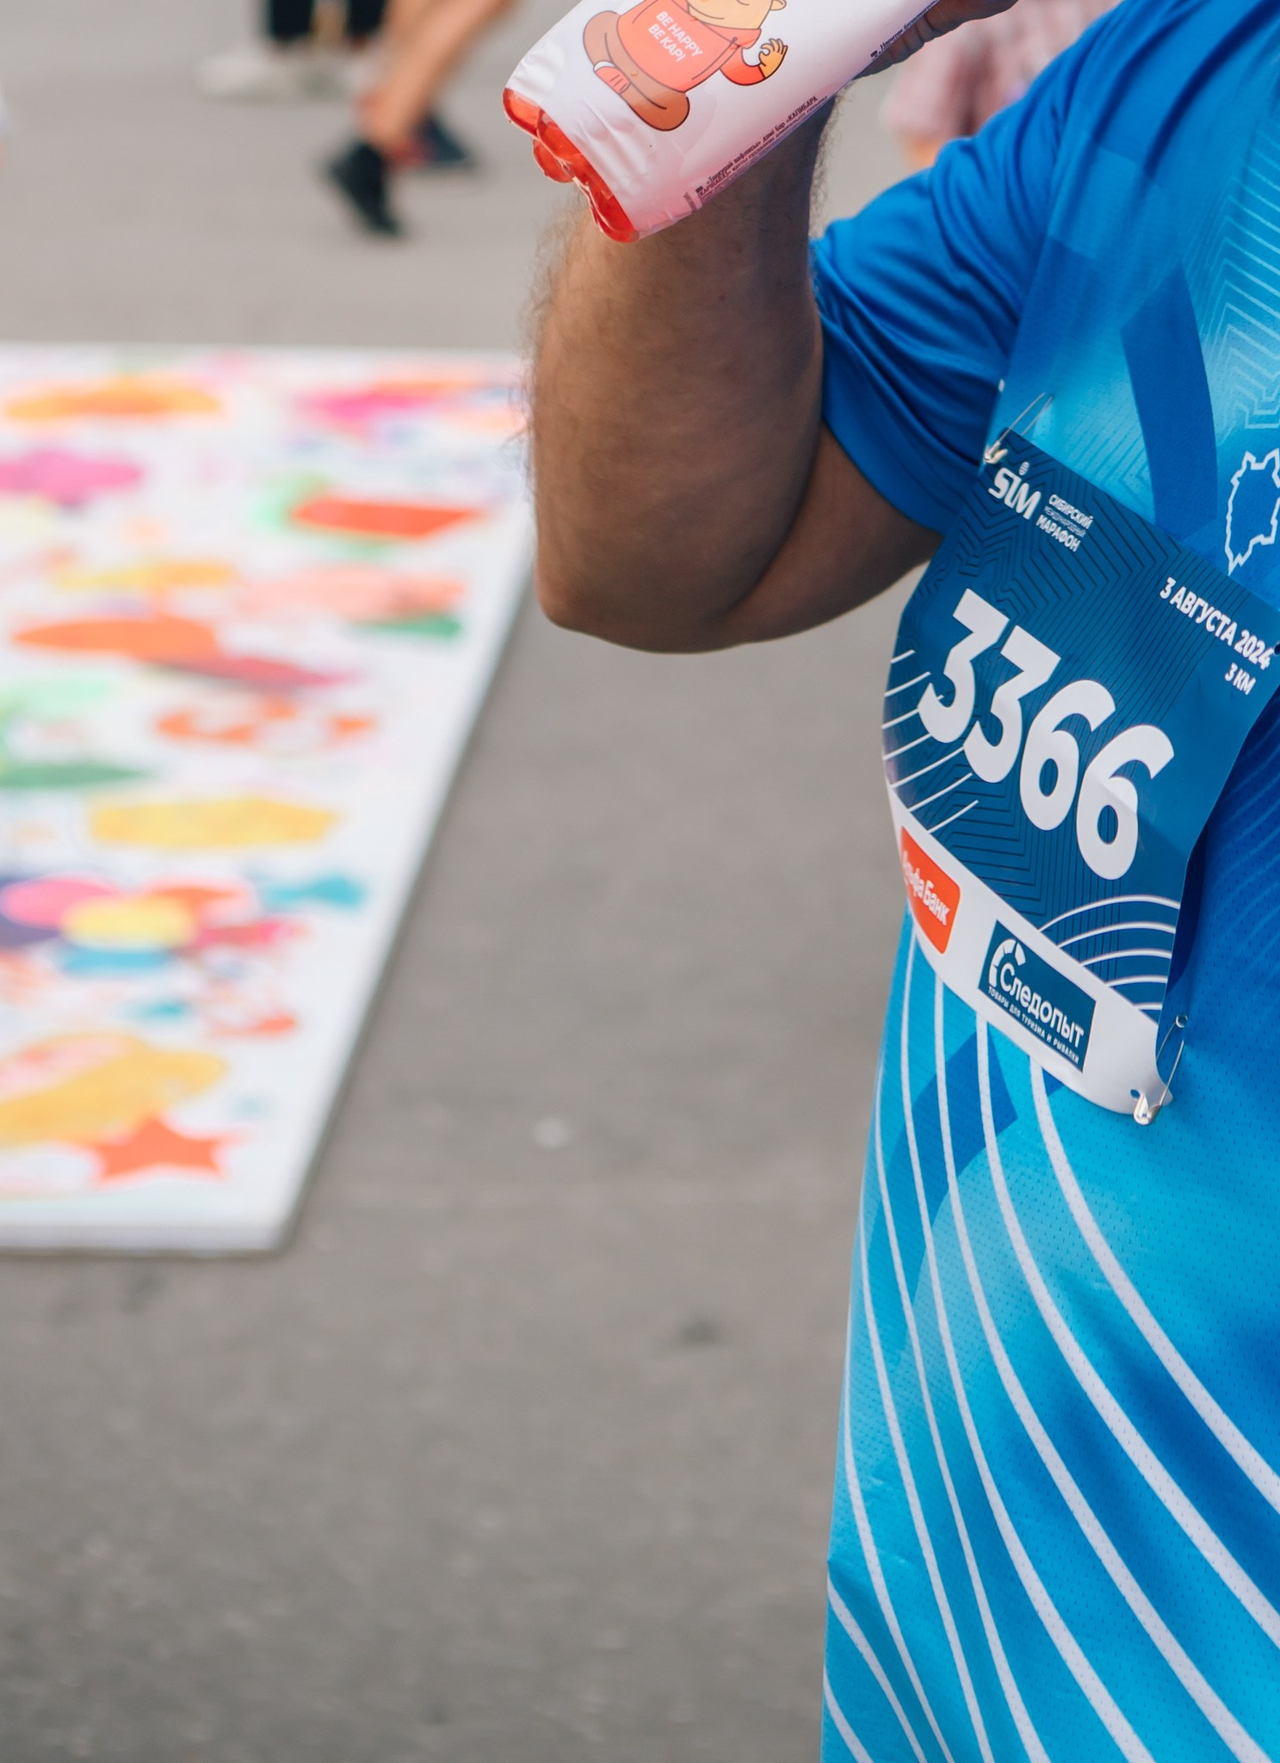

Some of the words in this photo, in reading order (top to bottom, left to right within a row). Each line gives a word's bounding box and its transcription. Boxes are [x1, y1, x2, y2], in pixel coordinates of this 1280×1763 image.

[648, 24, 666, 40] BE
[660, 36, 686, 62] KAPI
[656, 10, 674, 27] BE
[668, 23, 703, 57] HAPPY
[1035, 514, 1081, 552] МАРАФОН
[1048, 494, 1094, 529] СИБИРСКИЙ
[1159, 576, 1177, 599] 3
[1169, 586, 1238, 647] АВГУСТА
[1234, 629, 1274, 670] 2024
[1224, 662, 1238, 682] 3
[1233, 668, 1256, 696] КМ
[917, 588, 1174, 881] 3366
[922, 879, 951, 926] Банк
[988, 986, 1010, 1008] ТОВАРЫ
[1009, 1004, 1021, 1018] ДЛЯ
[1021, 1014, 1046, 1038] ТУРИЗМА
[1046, 1033, 1053, 1043] И
[1053, 1038, 1080, 1065] РЫБАЛКИ
[1000, 962, 1085, 1048] Следопыт
